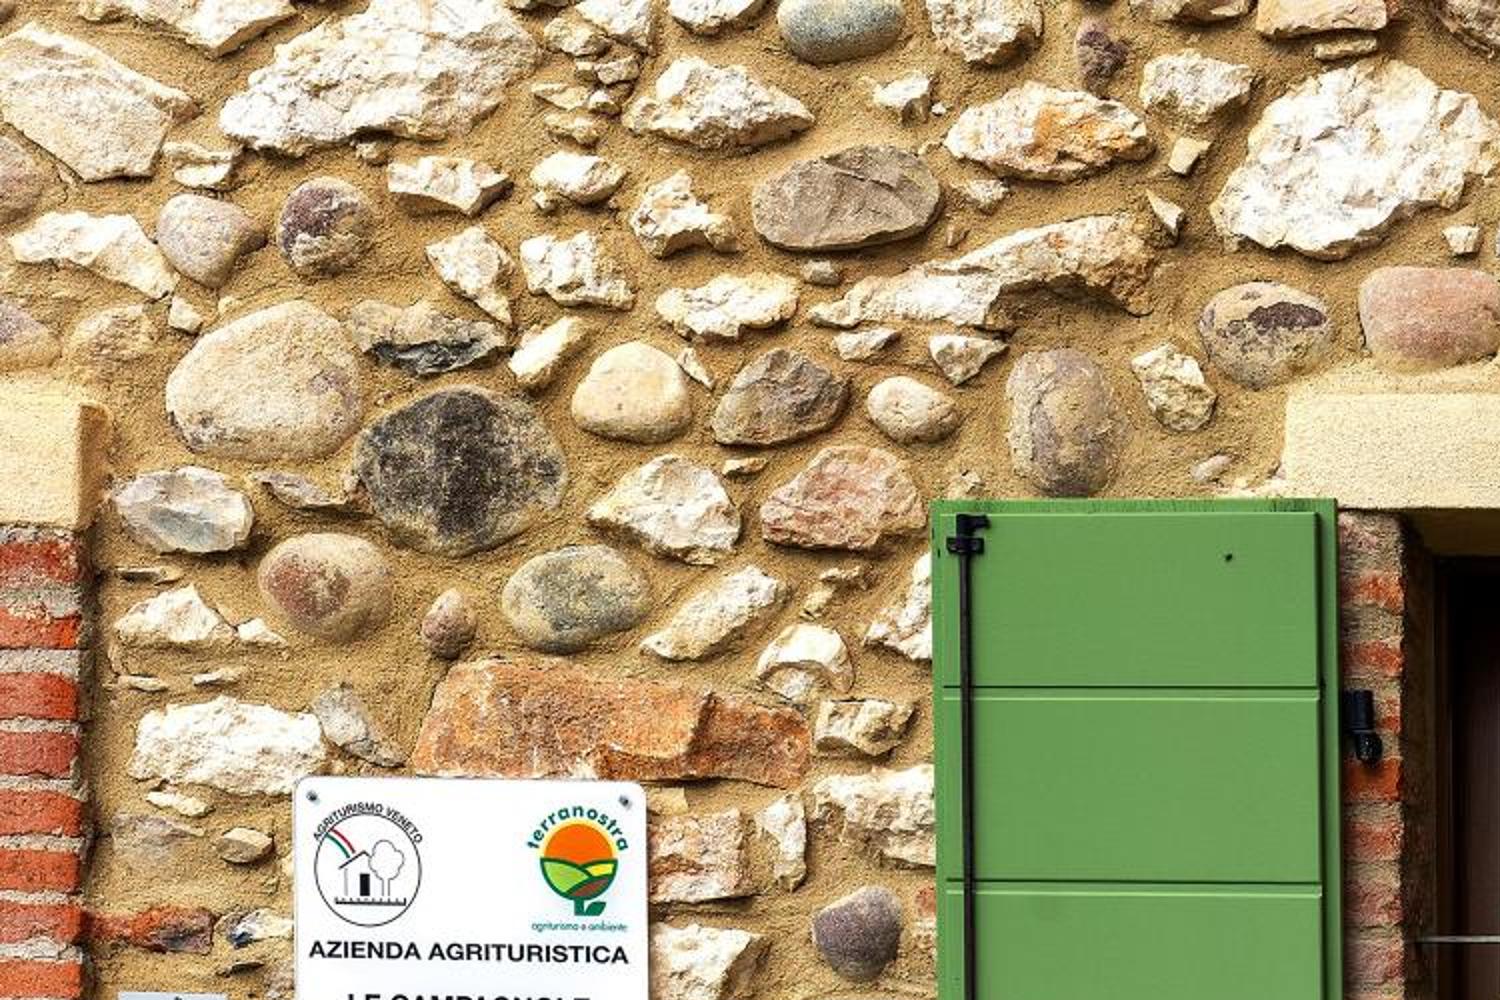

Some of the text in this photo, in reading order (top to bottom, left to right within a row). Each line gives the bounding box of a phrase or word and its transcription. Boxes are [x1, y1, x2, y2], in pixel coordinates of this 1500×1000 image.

[313, 802, 423, 843] AGRITURISMO VENETO
[527, 805, 629, 851] terranostra
[309, 940, 629, 964] AZIENDA AGRITURISTICA
